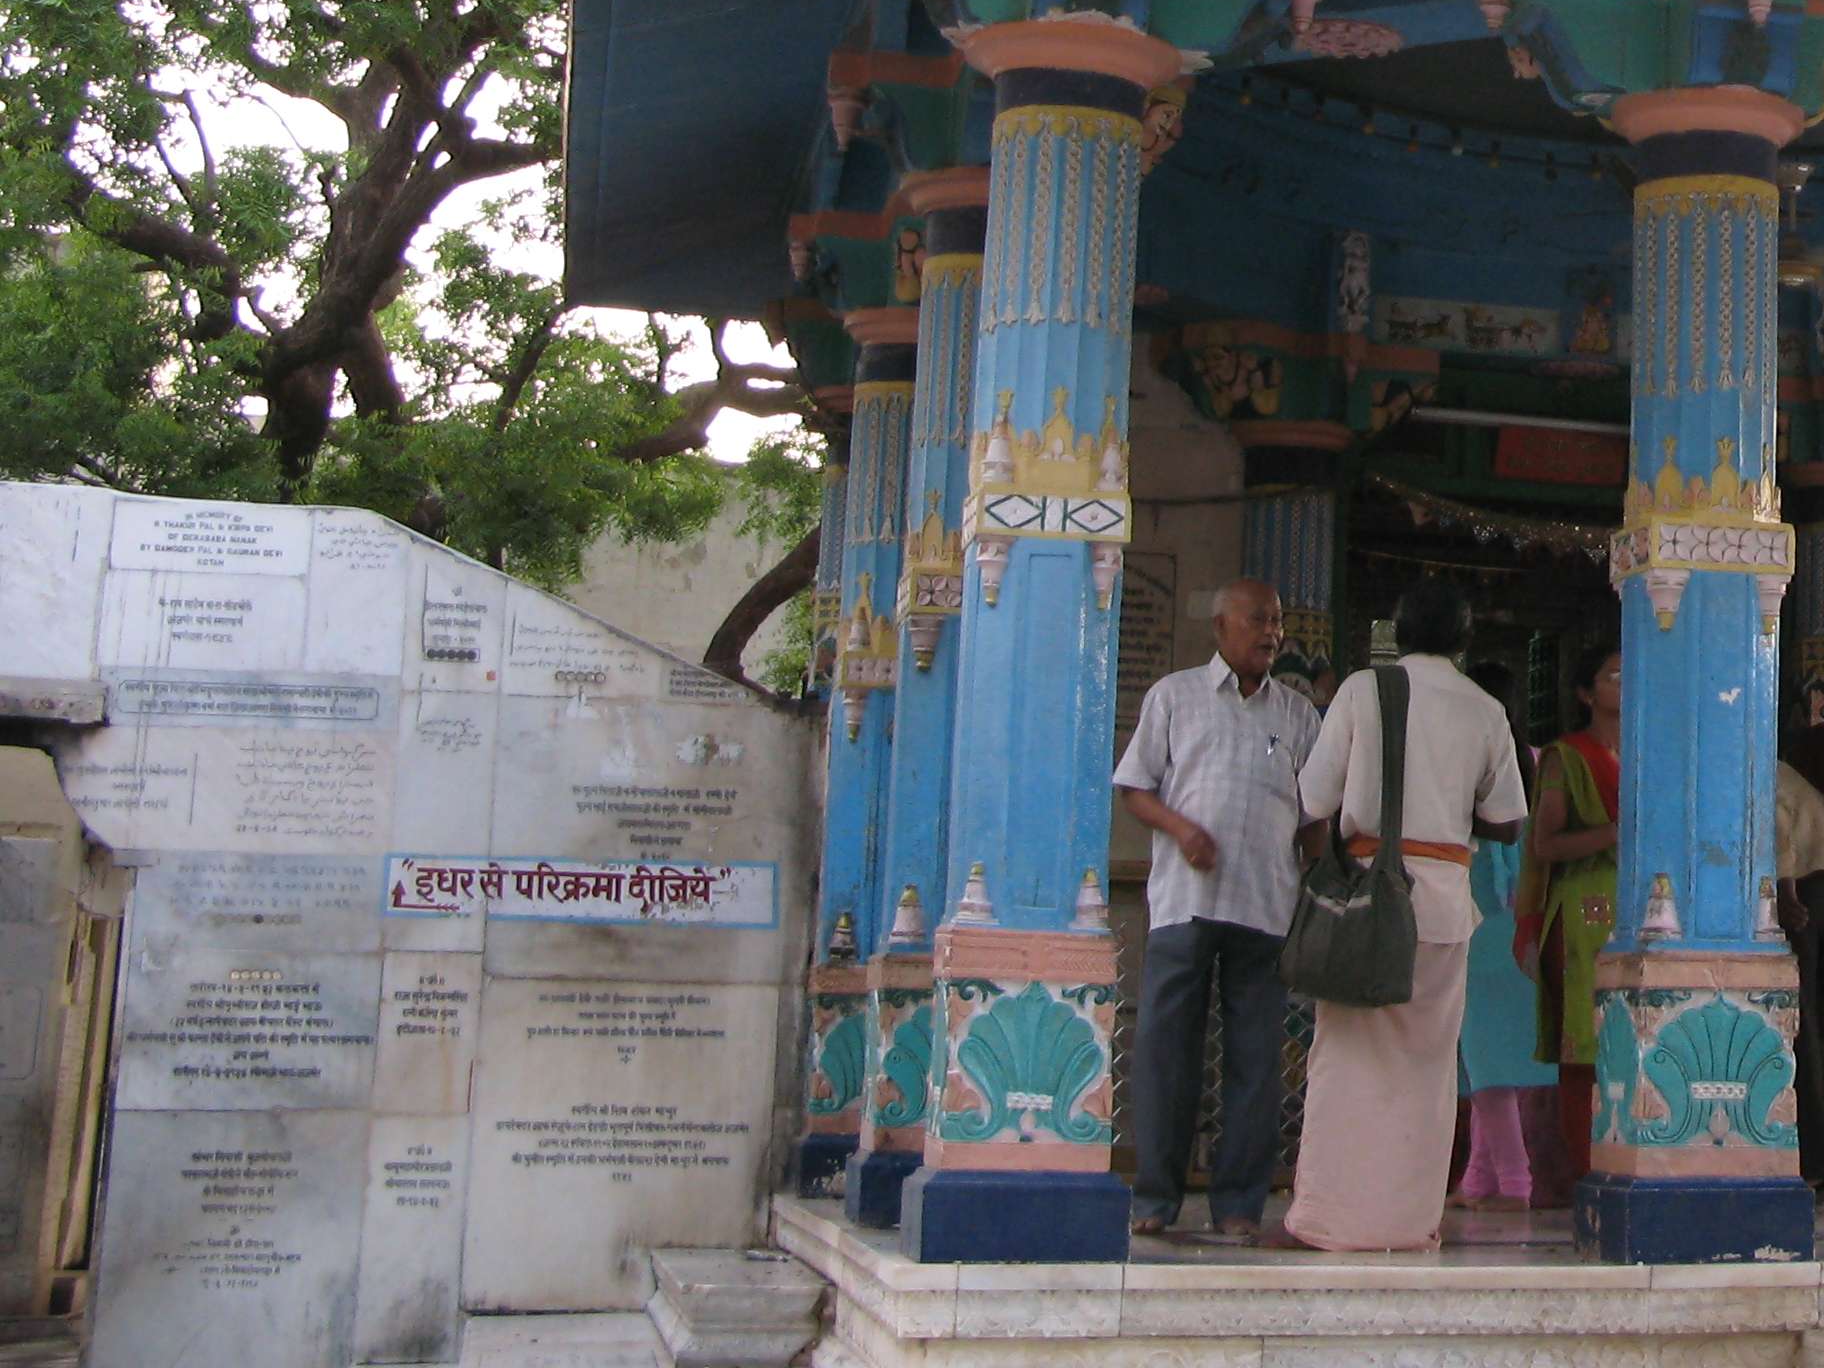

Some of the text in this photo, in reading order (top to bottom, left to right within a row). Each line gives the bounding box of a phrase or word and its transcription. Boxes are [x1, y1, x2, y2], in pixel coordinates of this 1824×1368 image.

[196, 511, 231, 521] MEMORY
[199, 521, 215, 530] PAL
[254, 525, 274, 533] DEVI
[168, 533, 178, 541] OF
[229, 536, 258, 544] NANAK
[140, 543, 151, 552] BY
[198, 545, 213, 554] PAL
[263, 549, 284, 558] DEVI
[478, 862, 507, 900] से
[511, 862, 625, 904] परिक्रमा
